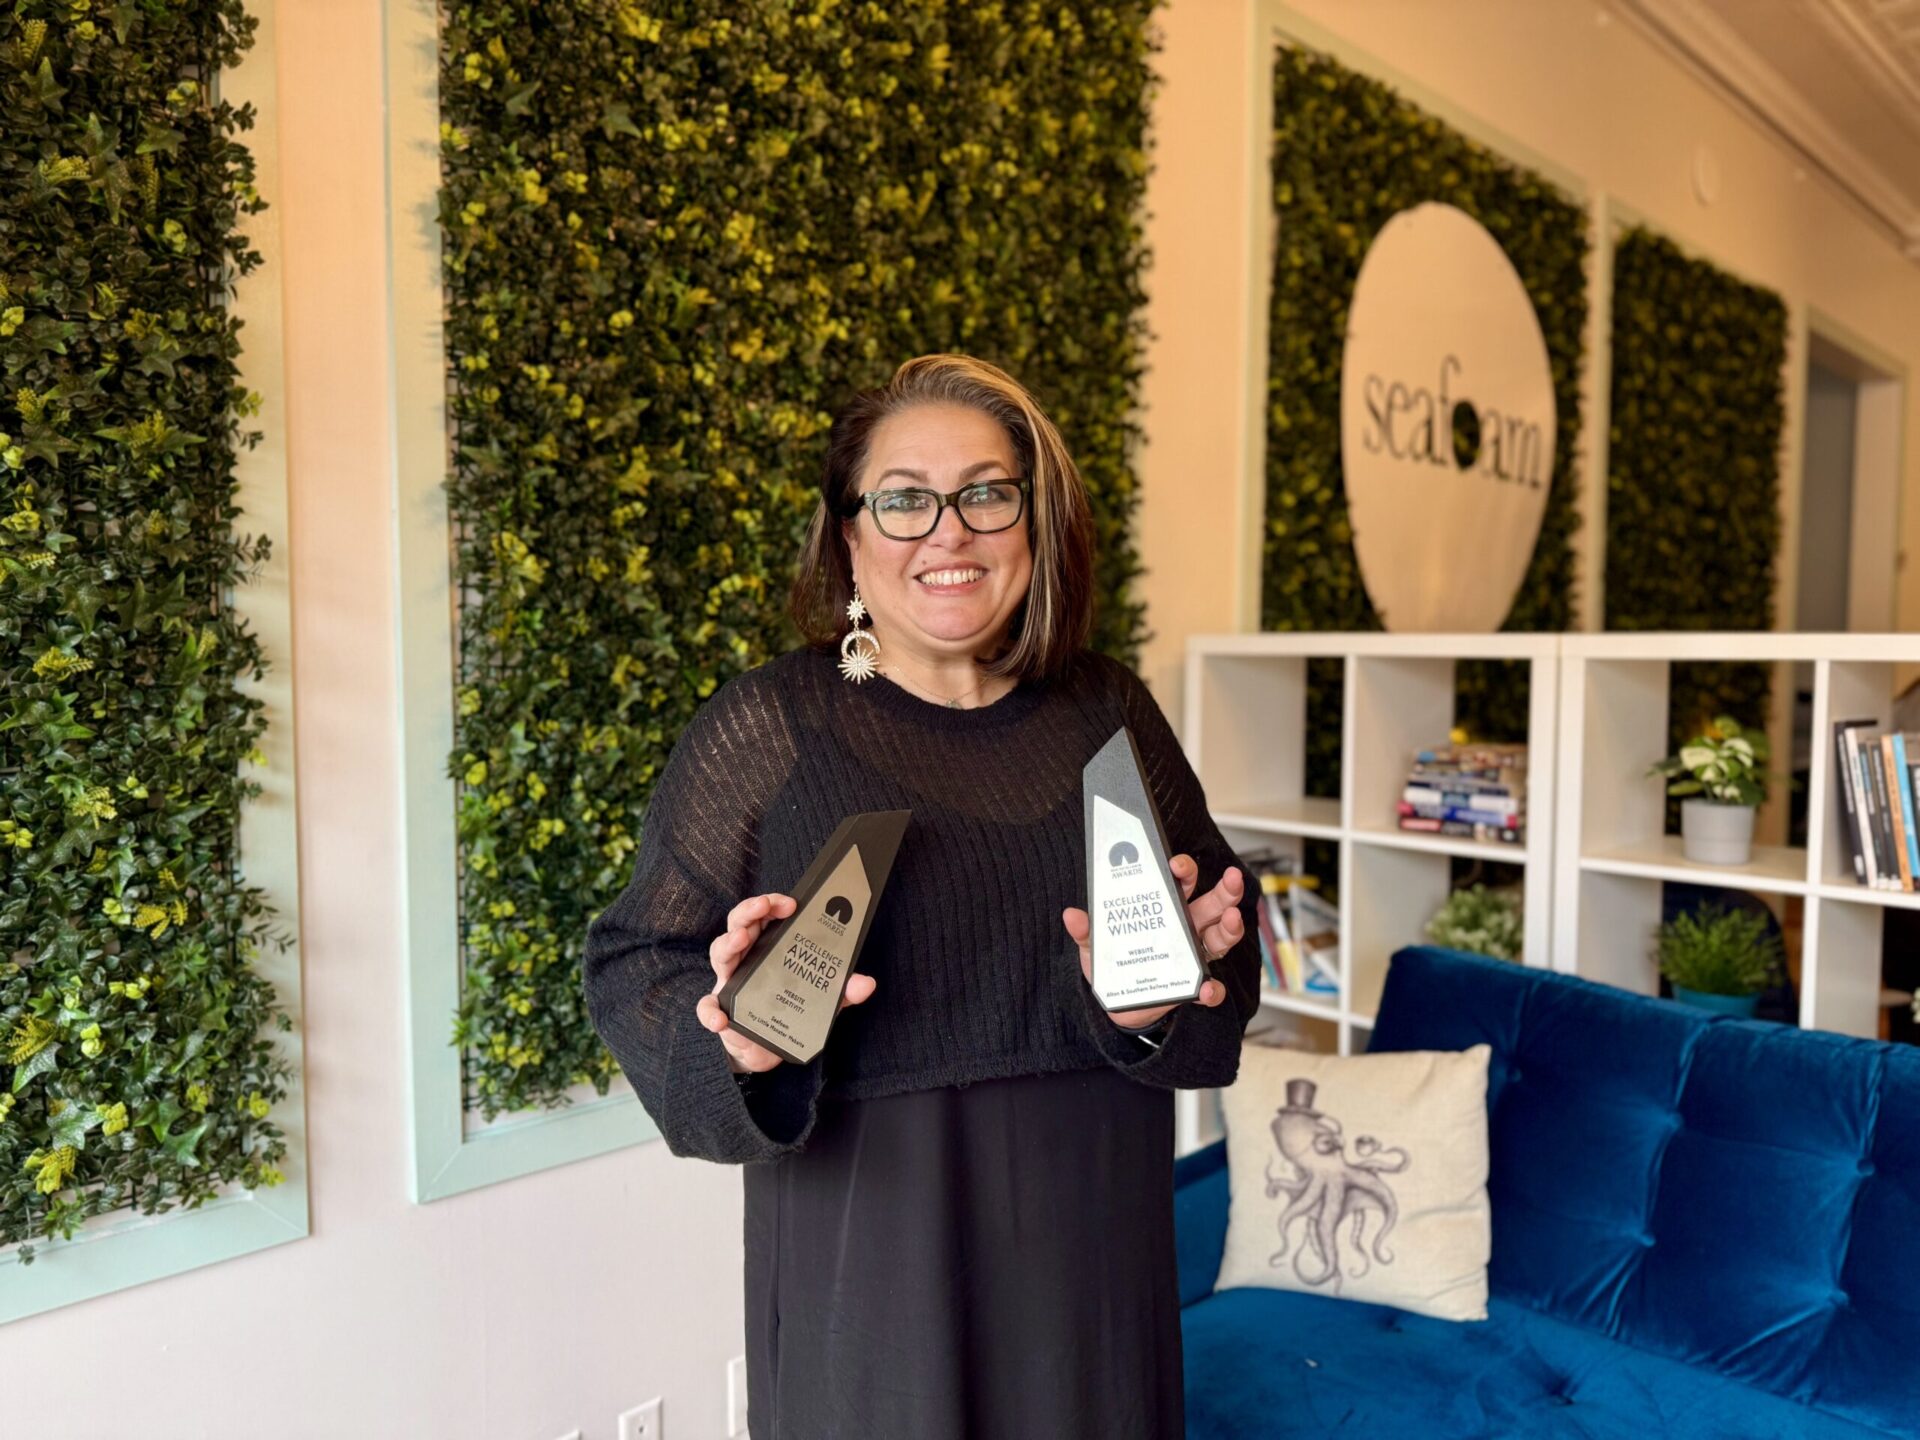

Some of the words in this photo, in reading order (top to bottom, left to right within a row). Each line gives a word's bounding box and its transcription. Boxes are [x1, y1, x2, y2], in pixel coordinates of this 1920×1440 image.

[1363, 353, 1542, 490] seafoam
[1112, 868, 1143, 879] AWARDS
[1103, 890, 1161, 909] EXCELLENCE
[1107, 901, 1163, 924] AWARD
[817, 917, 845, 937] AWARDS
[1108, 916, 1166, 936] WINNER
[794, 932, 843, 968] EXCELLENCE
[1116, 952, 1169, 967] TRANSPORTATION
[1128, 946, 1154, 956] WEBSITE
[787, 943, 837, 980] AWARD
[783, 955, 830, 993] WINNER
[775, 994, 805, 1014] CREATIVITY
[783, 989, 806, 1005] WEBSITE
